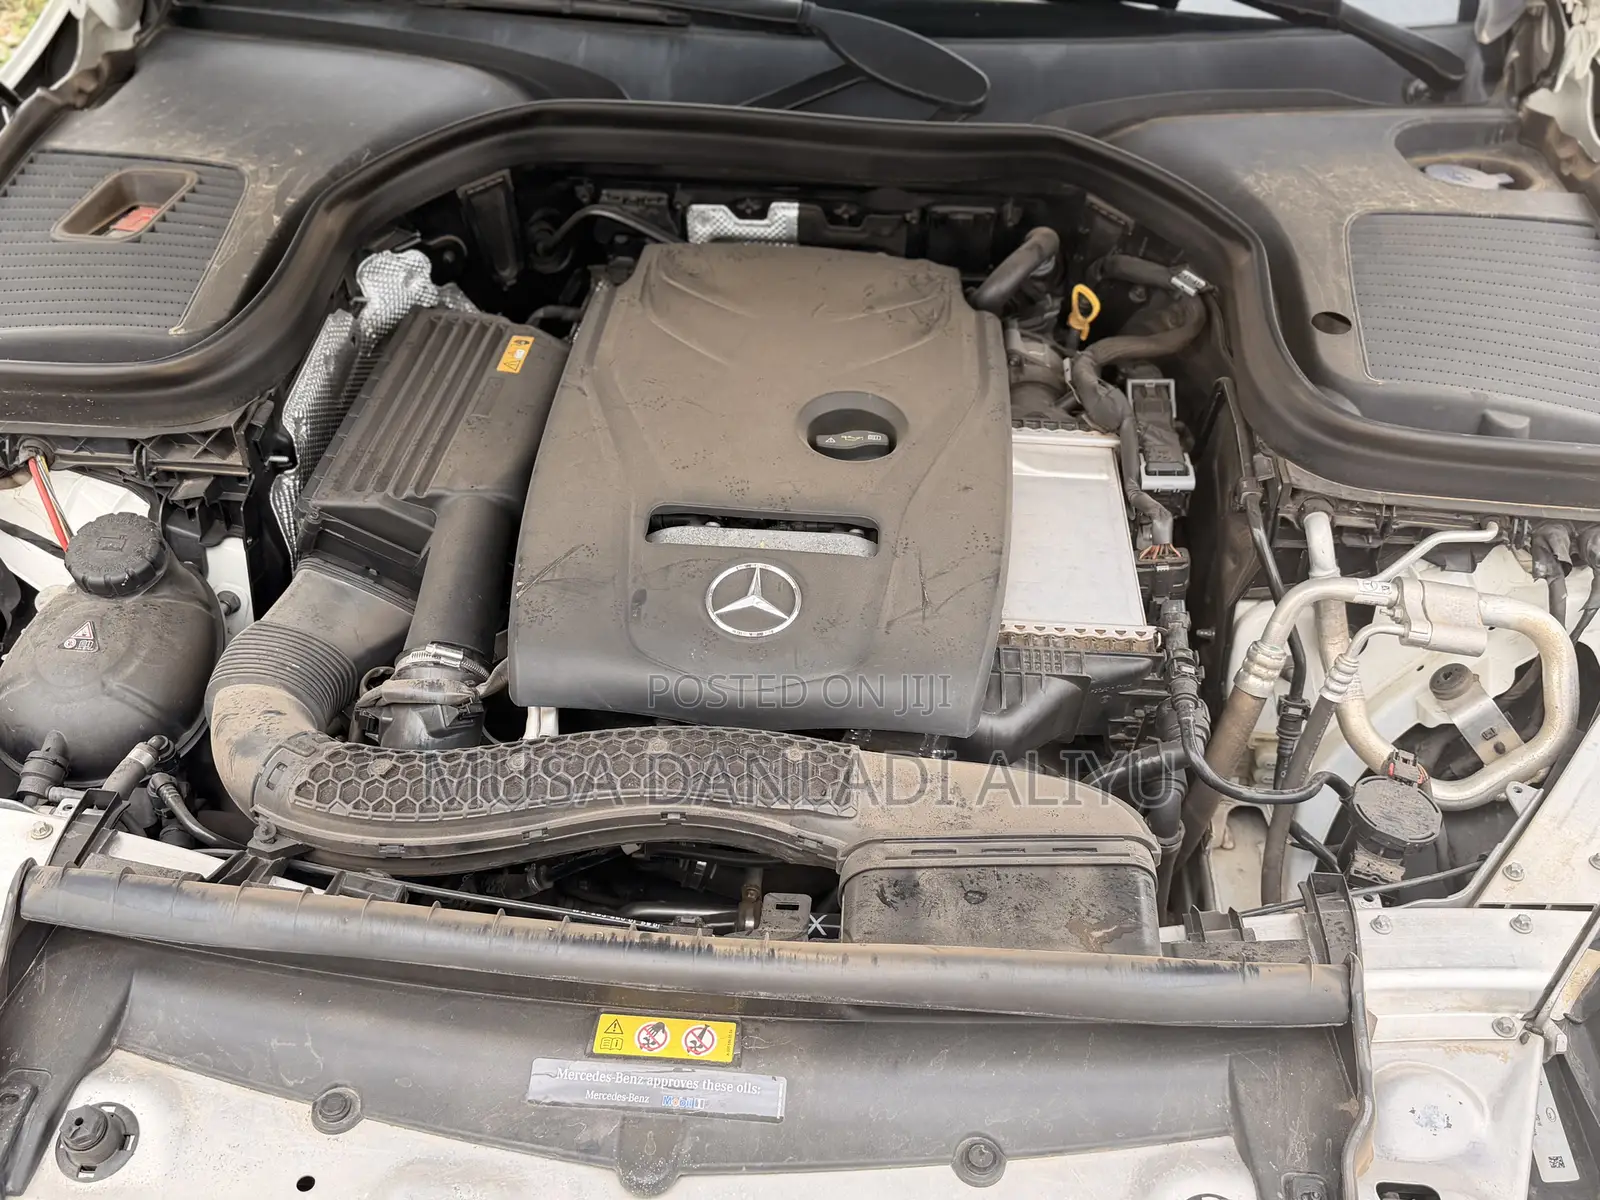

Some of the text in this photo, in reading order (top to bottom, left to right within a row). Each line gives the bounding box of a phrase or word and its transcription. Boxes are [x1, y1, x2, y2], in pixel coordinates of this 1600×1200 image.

[556, 1067, 761, 1095] Mercedes-Benz approves these oils:
[585, 1089, 650, 1104] Mercedes-Benz
